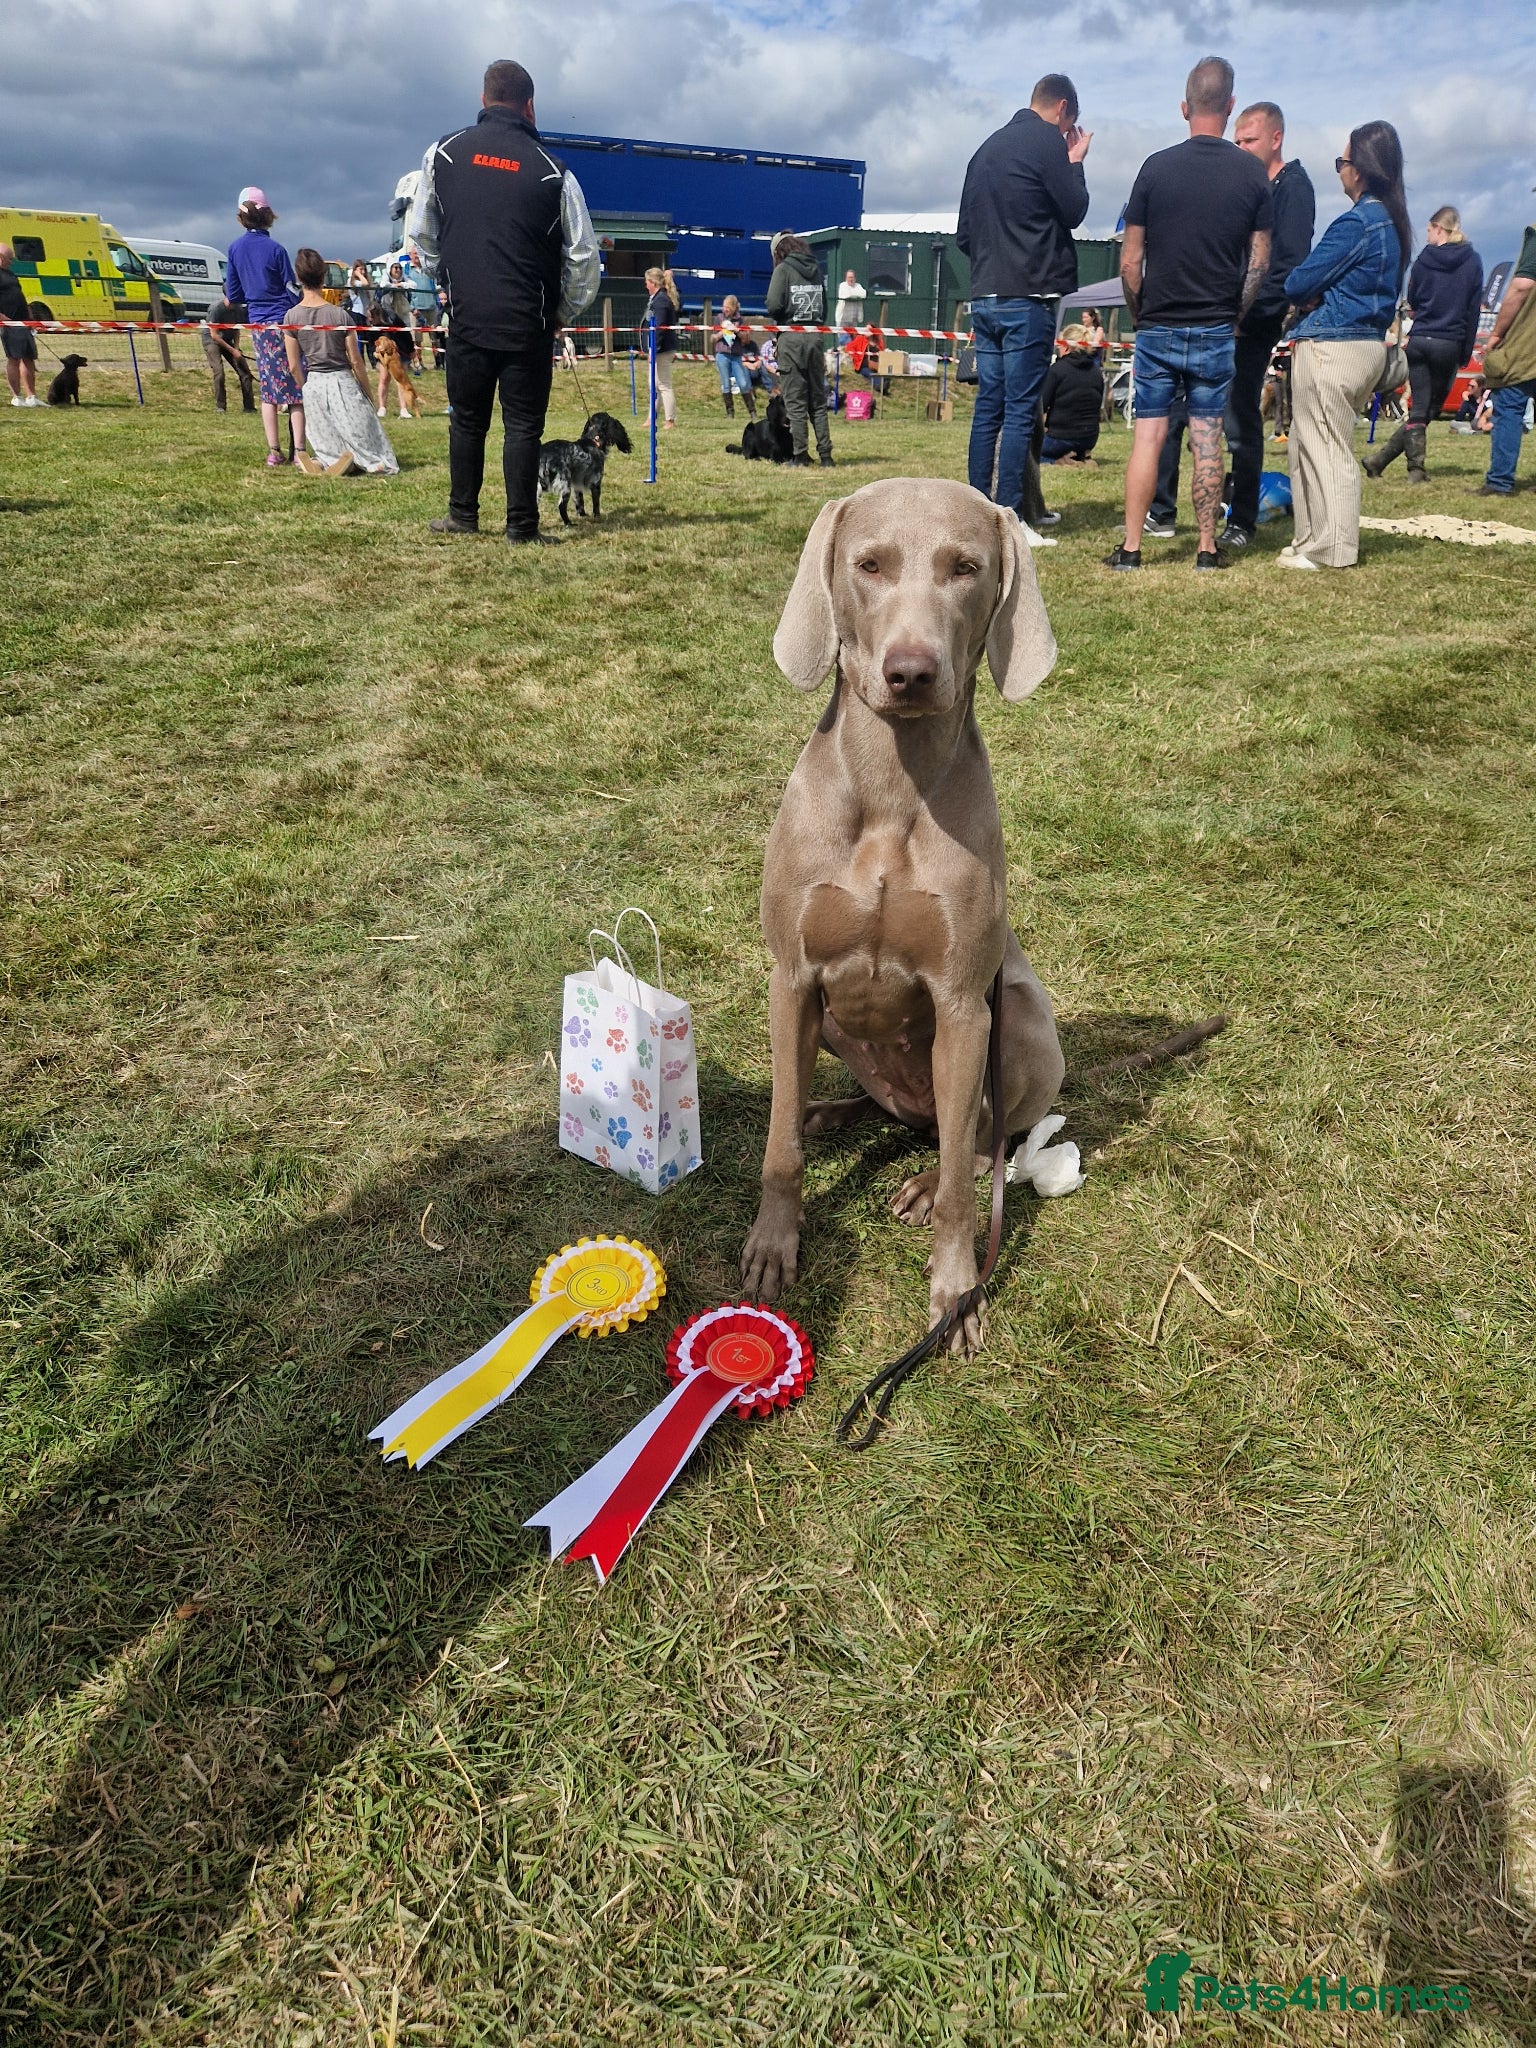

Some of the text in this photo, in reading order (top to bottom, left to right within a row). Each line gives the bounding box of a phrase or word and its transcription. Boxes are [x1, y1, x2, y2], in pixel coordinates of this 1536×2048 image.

[473, 154, 521, 172] CLAAS
[36, 215, 79, 225] AMBULANCE
[586, 1277, 607, 1295] 3RD
[731, 1347, 752, 1365] 1ST
